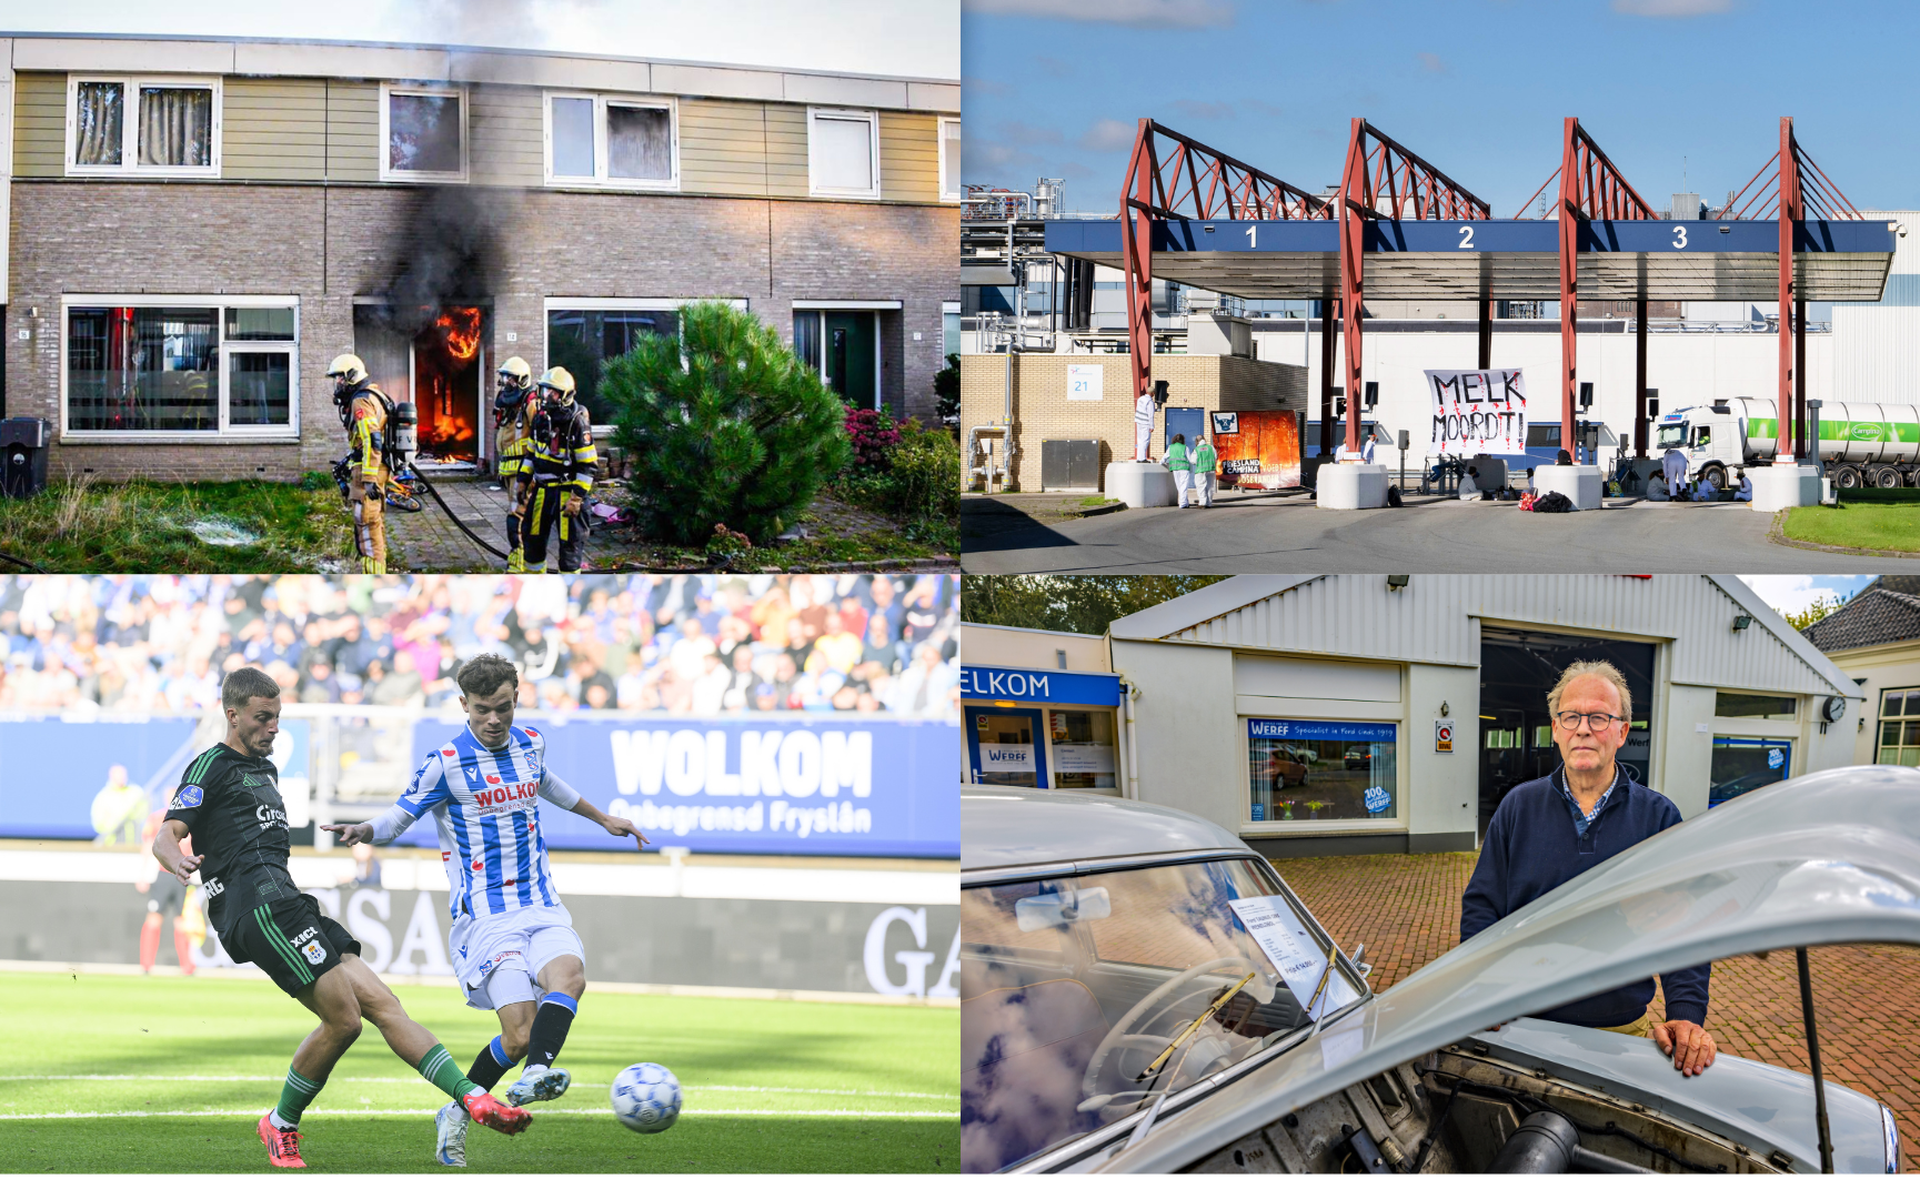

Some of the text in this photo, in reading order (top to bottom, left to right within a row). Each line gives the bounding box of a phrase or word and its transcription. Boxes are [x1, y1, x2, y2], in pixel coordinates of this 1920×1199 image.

[1246, 225, 1257, 249] 1
[1459, 226, 1474, 249] 2
[1672, 226, 1688, 249] 3
[1074, 380, 1088, 392] 21
[1433, 371, 1526, 405] MELK
[1432, 411, 1524, 443] MOORDT!
[960, 670, 1049, 697] ELKOM
[1294, 726, 1329, 736] Specialist
[1340, 727, 1356, 735] Ford
[1377, 729, 1394, 737] 1919
[610, 729, 872, 797] WOLKOM
[1364, 786, 1382, 799] 100
[769, 800, 872, 838] Fryslân
